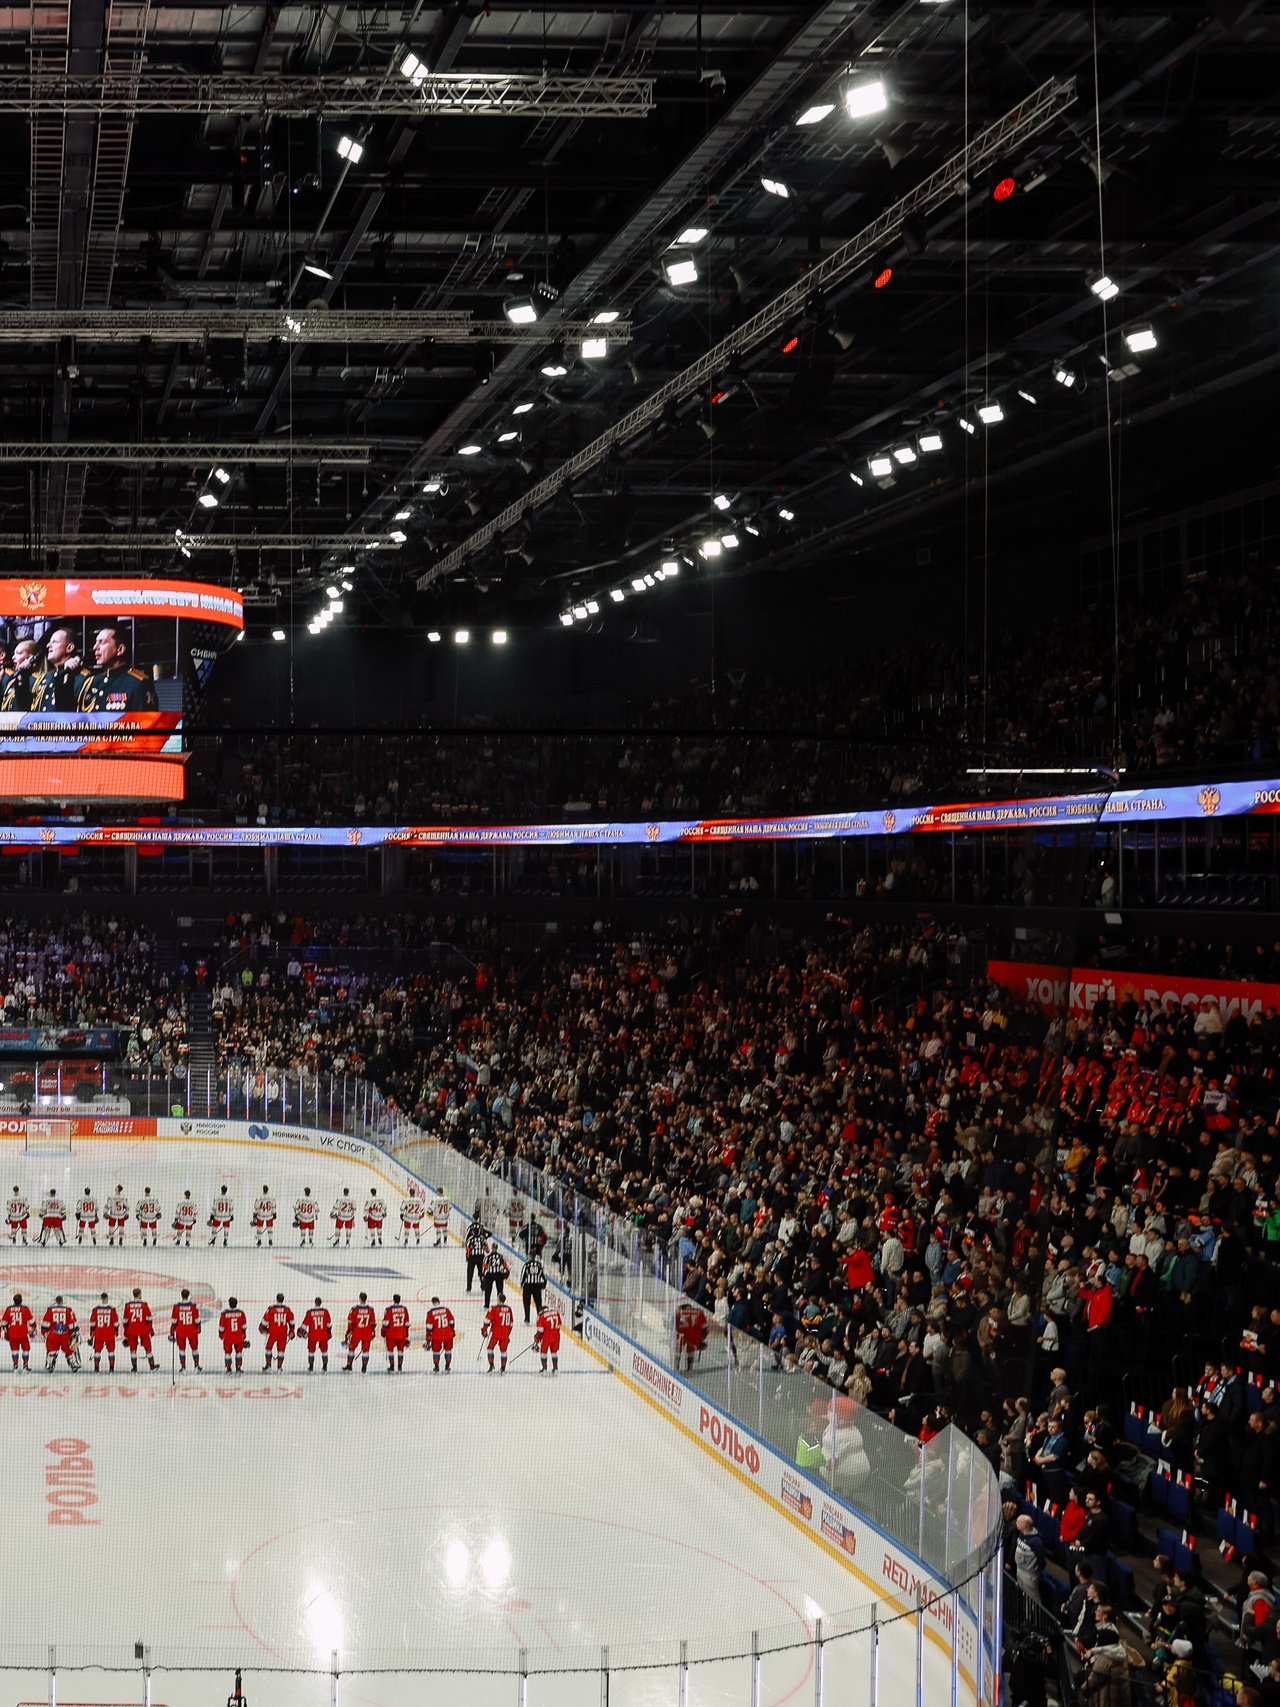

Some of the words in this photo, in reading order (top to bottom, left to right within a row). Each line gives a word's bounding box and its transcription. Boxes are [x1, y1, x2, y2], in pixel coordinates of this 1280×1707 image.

[1029, 805, 1057, 818] РОССИЯ
[1066, 803, 1104, 816] ЛЮБИМАЯ
[1105, 800, 1130, 813] НАША
[1131, 798, 1166, 811] СТРАНА.
[912, 814, 934, 825] РОССИЯ
[940, 812, 976, 825] СВЯЩЕННАЯ
[976, 809, 996, 821] НАША
[996, 807, 1028, 822] ДЕРЖАВА,
[77, 832, 103, 841] РОССИЯ
[206, 833, 233, 841] РОССИЯ
[513, 831, 539, 839] РОССИЯ
[680, 826, 704, 836] РОССИЯ
[1026, 977, 1116, 1011] ХОККЕЙ
[272, 1131, 310, 1141] НОРНИКЕЛЬ
[320, 1136, 334, 1147] VK
[336, 1139, 366, 1155] СПОРТ
[408, 1203, 420, 1214] 22
[437, 1203, 448, 1214] 70
[10, 1312, 22, 1326] 34
[97, 1314, 111, 1328] 89
[130, 1308, 143, 1322] 24
[179, 1311, 193, 1325] 96
[273, 1313, 287, 1326] 44
[357, 1314, 370, 1328] 27
[392, 1313, 405, 1327] 53
[434, 1314, 448, 1328] 76
[499, 1312, 511, 1326] 70
[230, 1318, 238, 1332] 6
[312, 1316, 324, 1330] 14
[82, 1385, 304, 1399] КРАСНАЯ
[699, 1405, 761, 1474] РОЛЬФ
[44, 1437, 102, 1525] РОЛЬФ
[883, 1552, 909, 1592] RED
